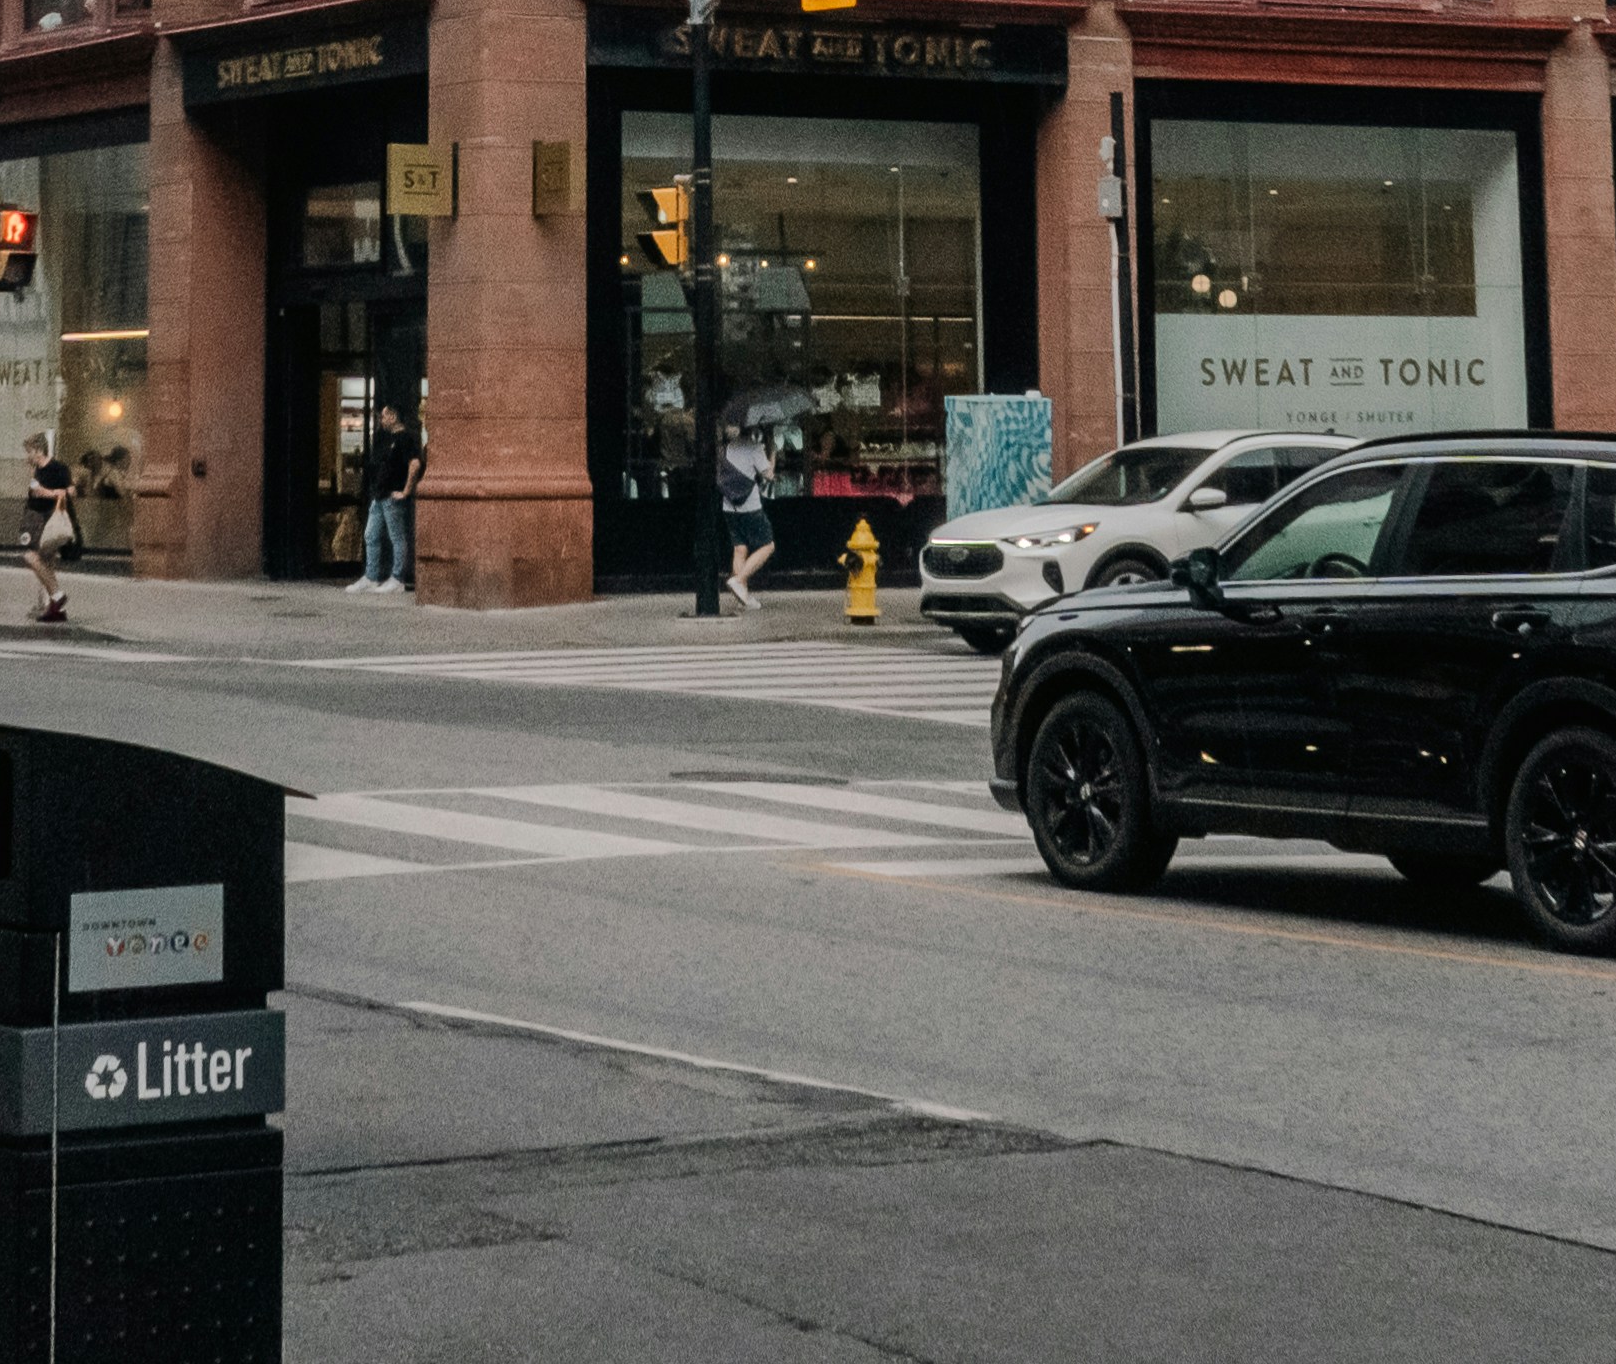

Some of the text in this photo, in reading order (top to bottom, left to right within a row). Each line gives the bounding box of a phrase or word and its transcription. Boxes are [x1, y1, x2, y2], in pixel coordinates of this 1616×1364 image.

[674, 25, 803, 59] SWEAT
[872, 35, 992, 67] TONIC
[217, 51, 282, 89] SWEAT
[1199, 357, 1487, 388] SWEAT AND TONIC
[1286, 411, 1340, 424] YONGE
[1356, 411, 1415, 424] SHUTER
[82, 918, 157, 932] DOWNTOWN
[136, 1040, 253, 1101] Litter
